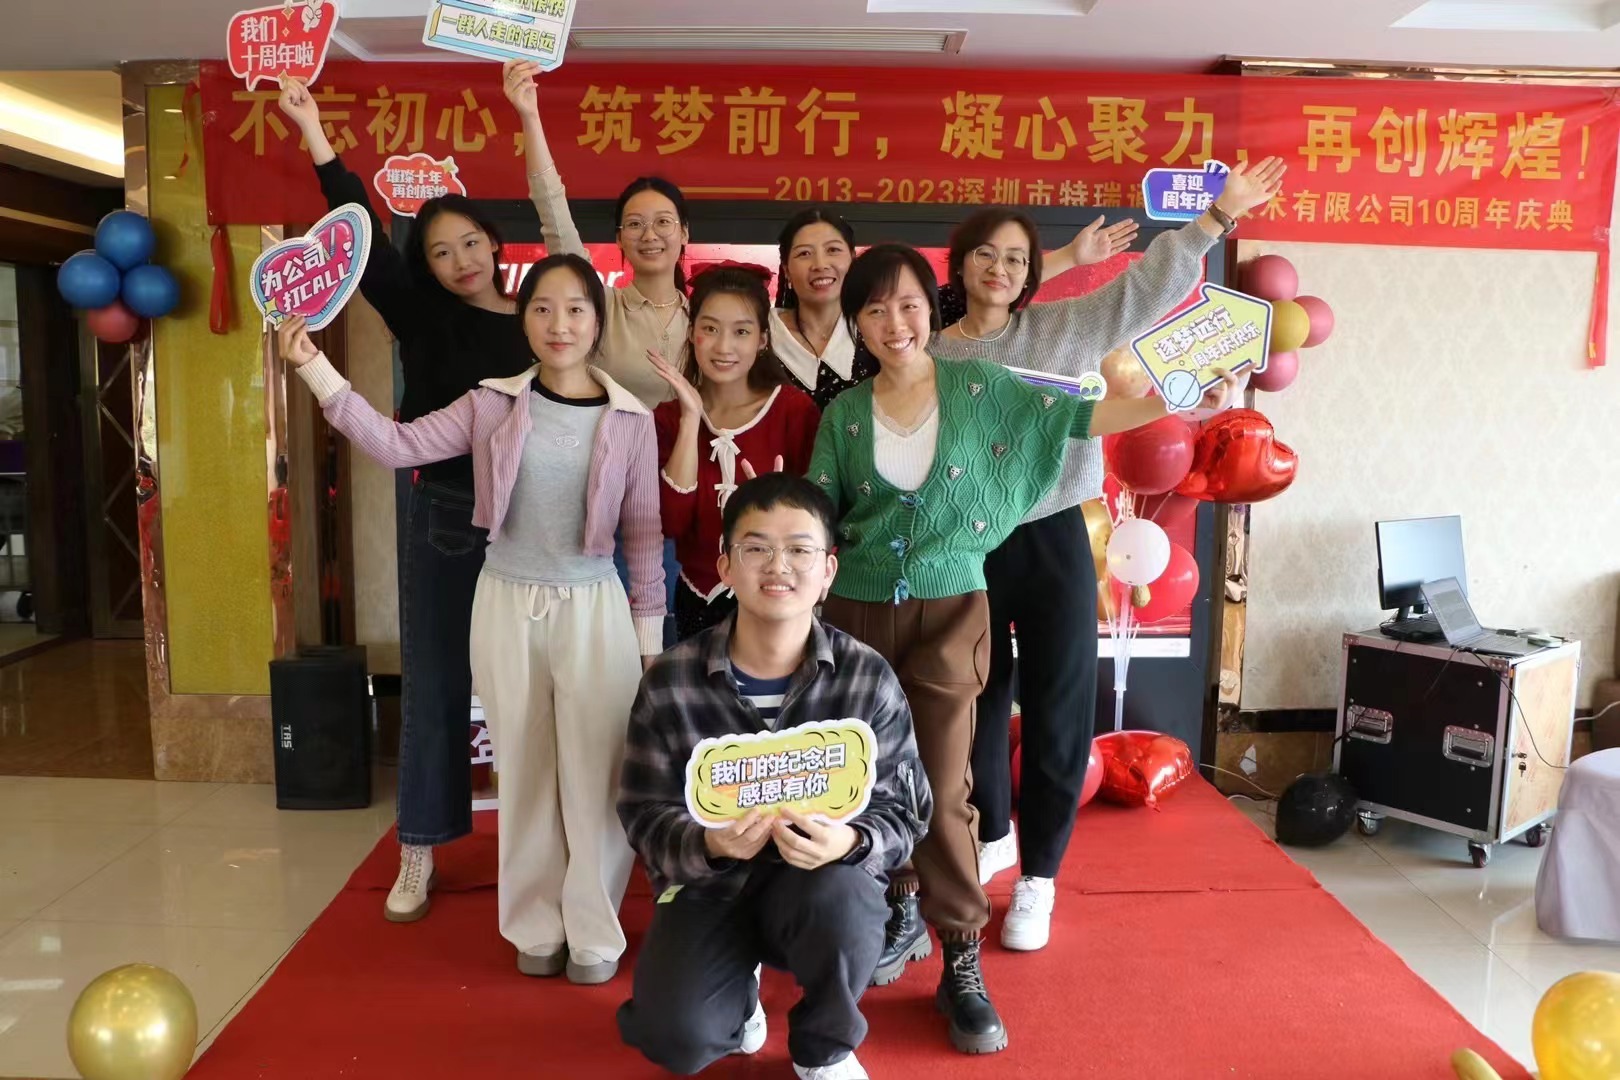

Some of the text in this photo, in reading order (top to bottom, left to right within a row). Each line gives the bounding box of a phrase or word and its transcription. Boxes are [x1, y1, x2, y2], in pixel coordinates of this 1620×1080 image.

[241, 16, 277, 43] 我们
[442, 13, 556, 54] 一群人走的很远
[241, 41, 315, 71] 十周年啦
[386, 169, 442, 184] 璀璨十年
[1172, 174, 1204, 191] 喜迎
[1162, 191, 1214, 210] 周年庆
[262, 240, 327, 296] 为公司
[283, 263, 352, 312] 打CALL
[1153, 305, 1235, 363] 逐梦远行
[1192, 320, 1262, 370] 周年庆快乐
[283, 725, 292, 749] TAS
[711, 743, 846, 786] 我们的纪念日
[737, 773, 829, 808] 感恩有你
